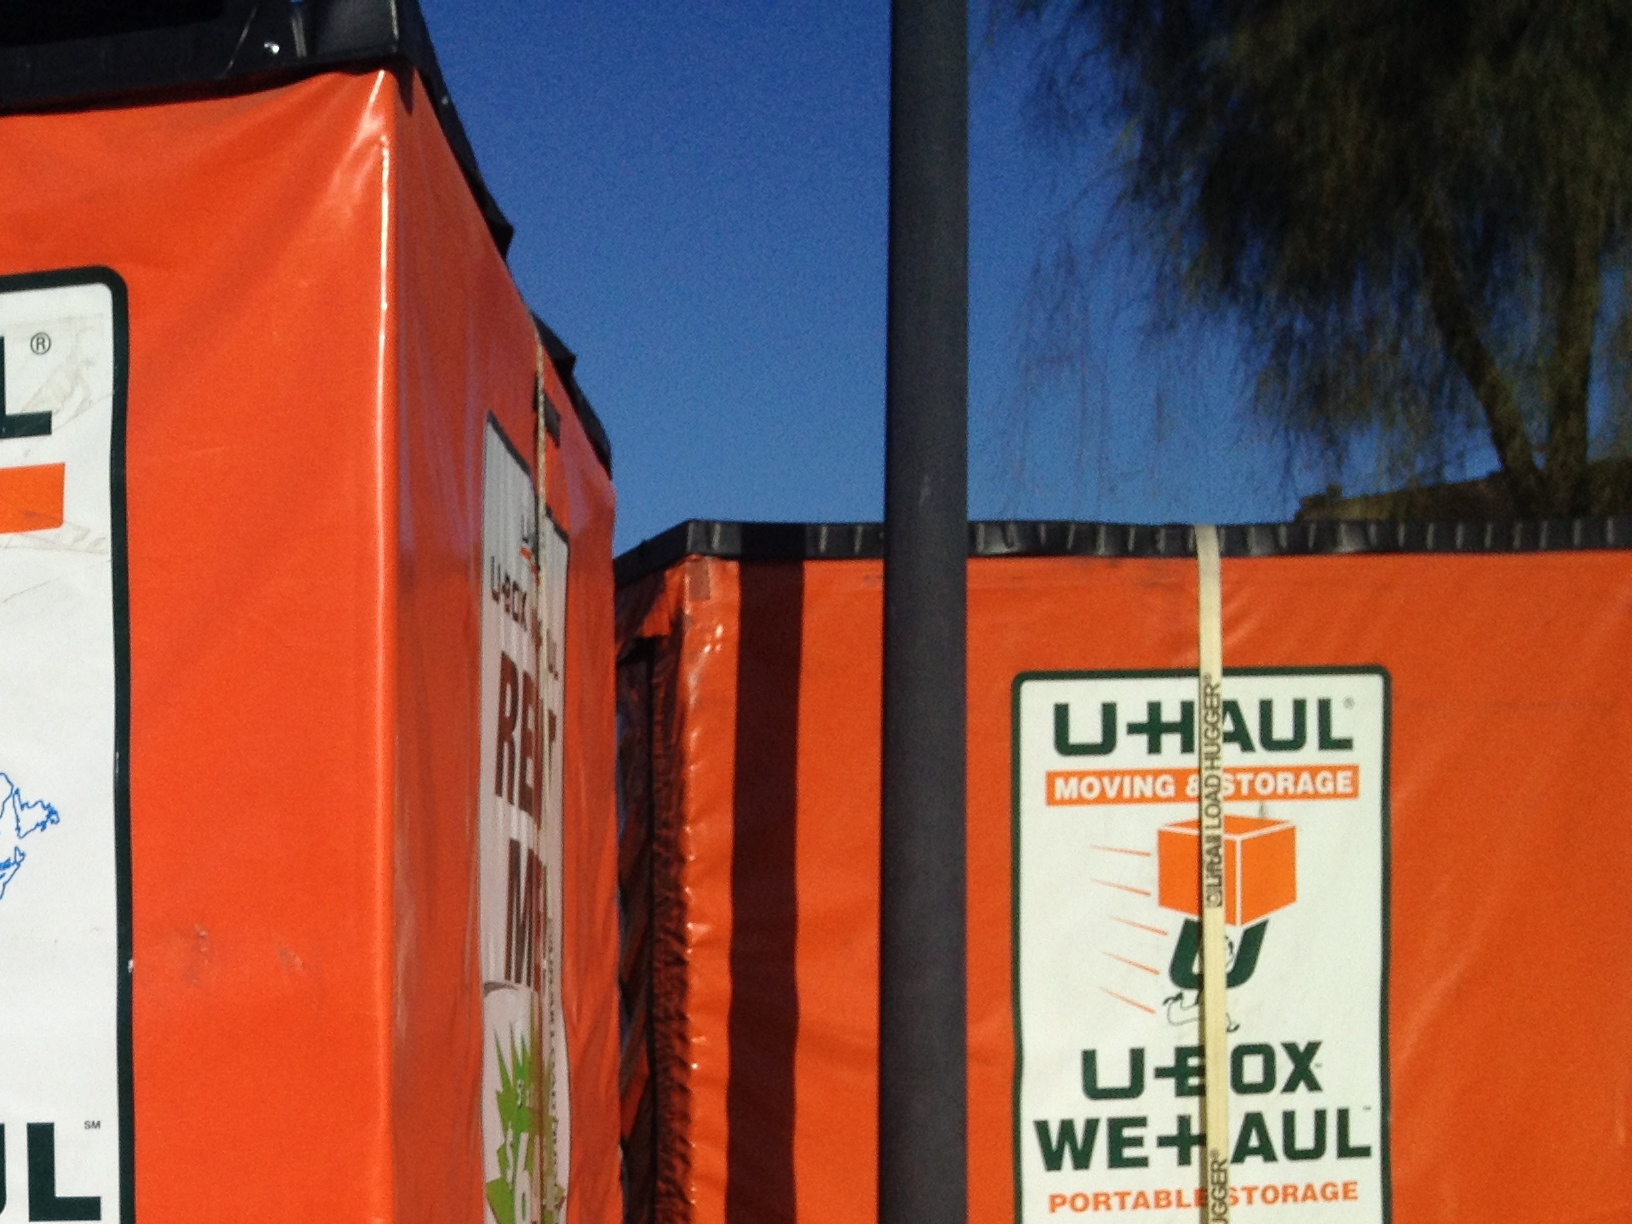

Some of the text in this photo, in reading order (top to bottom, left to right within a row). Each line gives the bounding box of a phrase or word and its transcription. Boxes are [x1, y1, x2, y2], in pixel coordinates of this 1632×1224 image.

[1203, 682, 1222, 771] HUGGER
[1054, 774, 1175, 801] MOVING
[1220, 771, 1354, 798] STORAGE
[1205, 774, 1222, 830] LOAD
